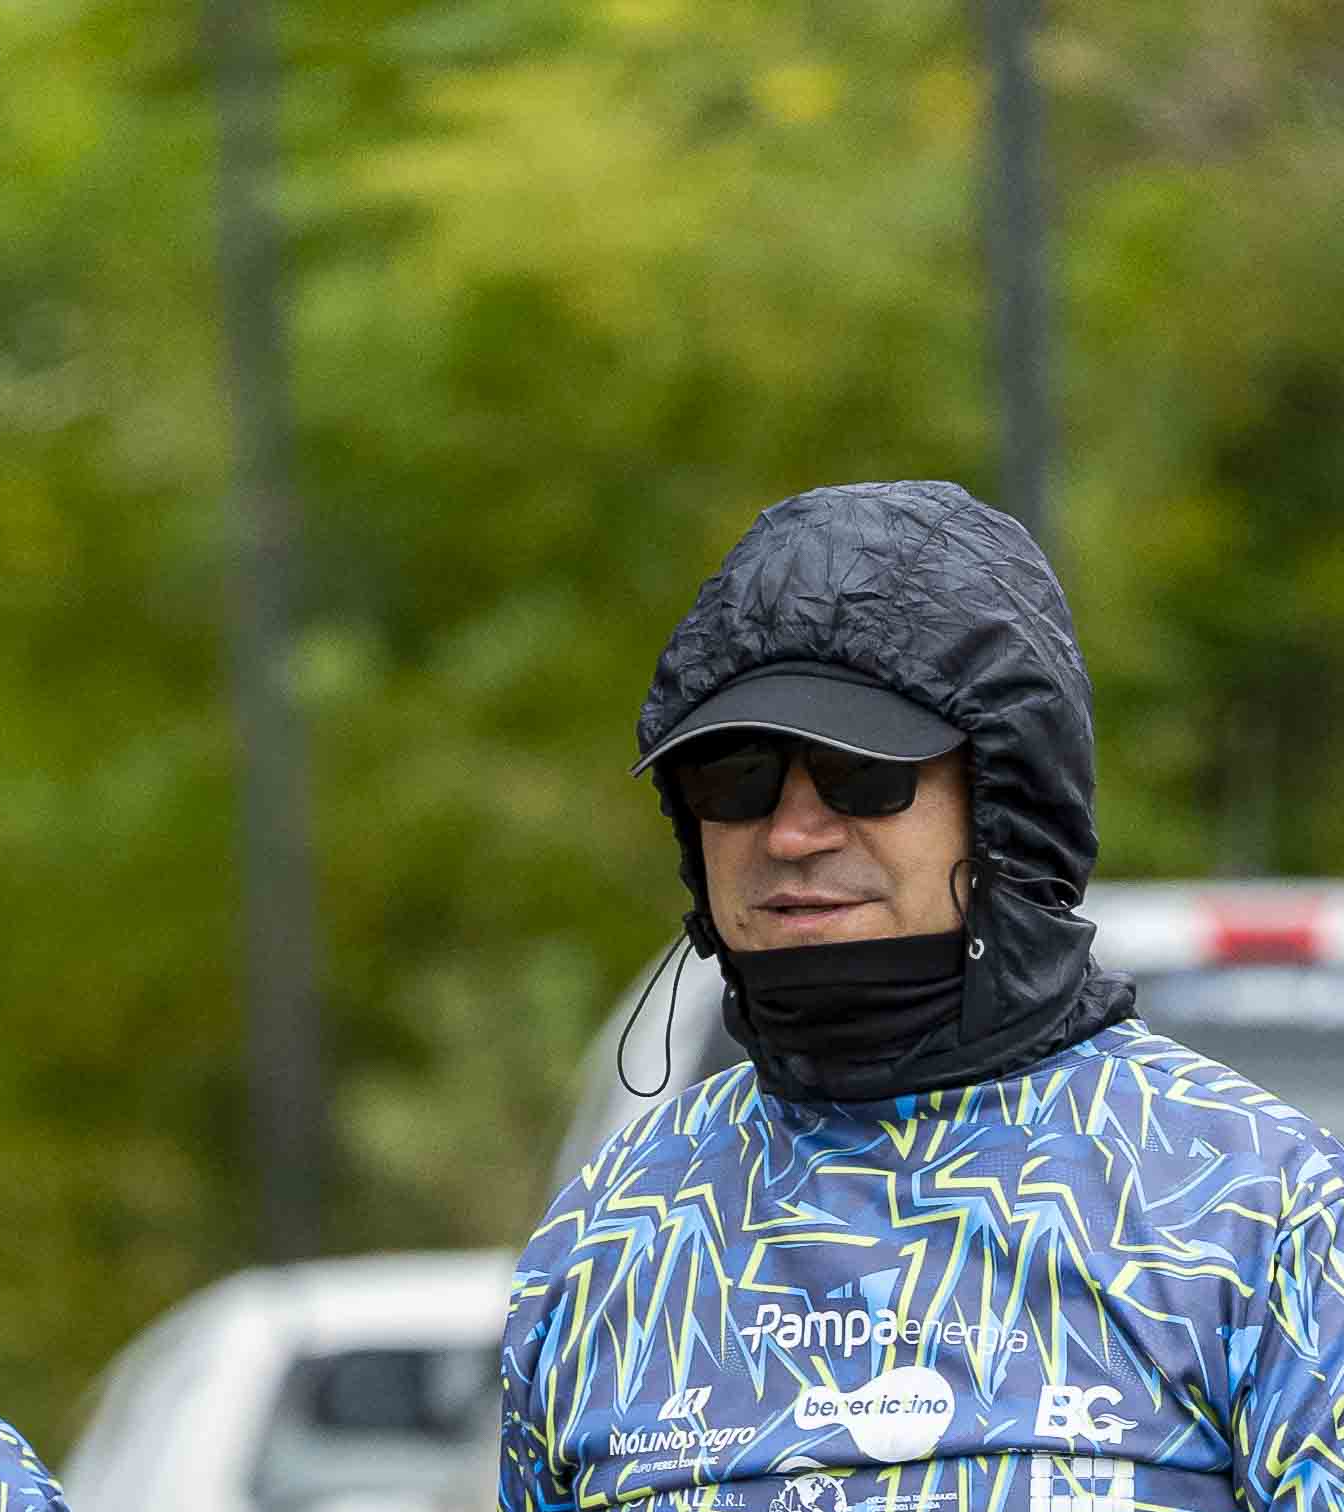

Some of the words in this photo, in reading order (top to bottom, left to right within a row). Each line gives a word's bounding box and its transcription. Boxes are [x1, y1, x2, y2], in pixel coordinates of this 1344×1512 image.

[803, 1394, 948, 1416] beeicino
[609, 1431, 696, 1455] MOLINOS
[700, 1427, 756, 1452] agro
